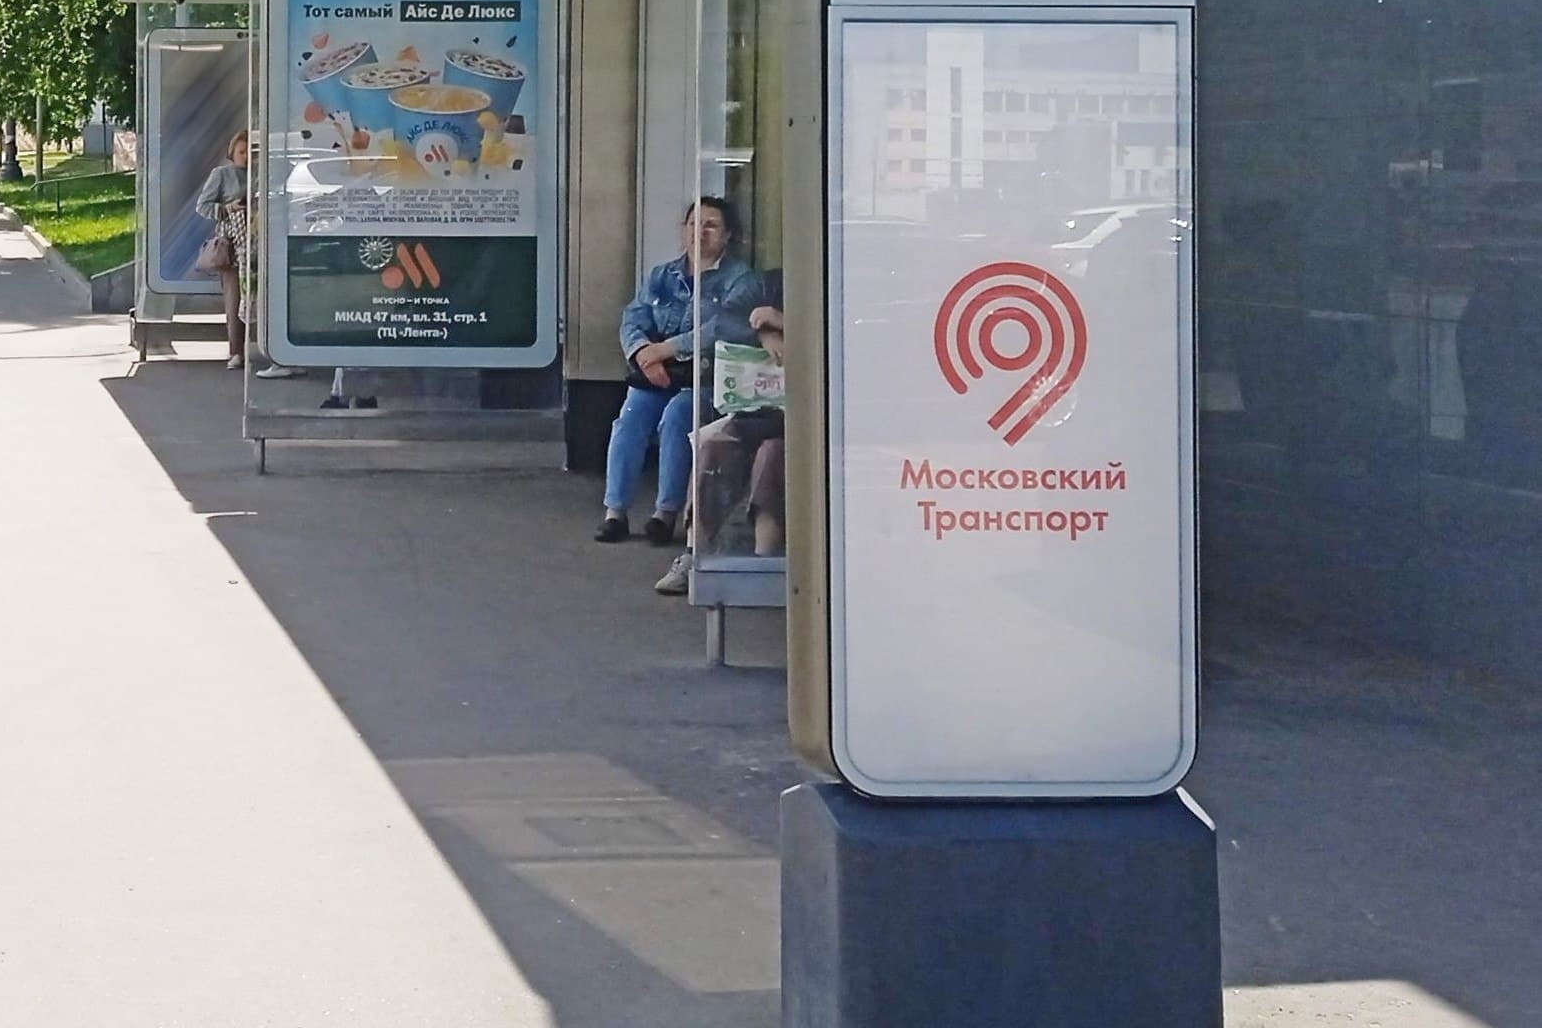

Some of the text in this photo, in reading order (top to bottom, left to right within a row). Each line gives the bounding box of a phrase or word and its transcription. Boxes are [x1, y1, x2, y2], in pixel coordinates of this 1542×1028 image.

[303, 3, 516, 21] Тот самый Айс Де Люкс
[372, 297, 406, 305] ВКУСНО
[414, 297, 422, 305] И
[422, 297, 450, 305] ТОЧКА
[334, 311, 487, 325] МКАД 47 км, вл. 31, стр. 1
[377, 327, 397, 340] (ТЦ
[900, 459, 1126, 490] Московский
[917, 500, 1109, 541] Транспорт
